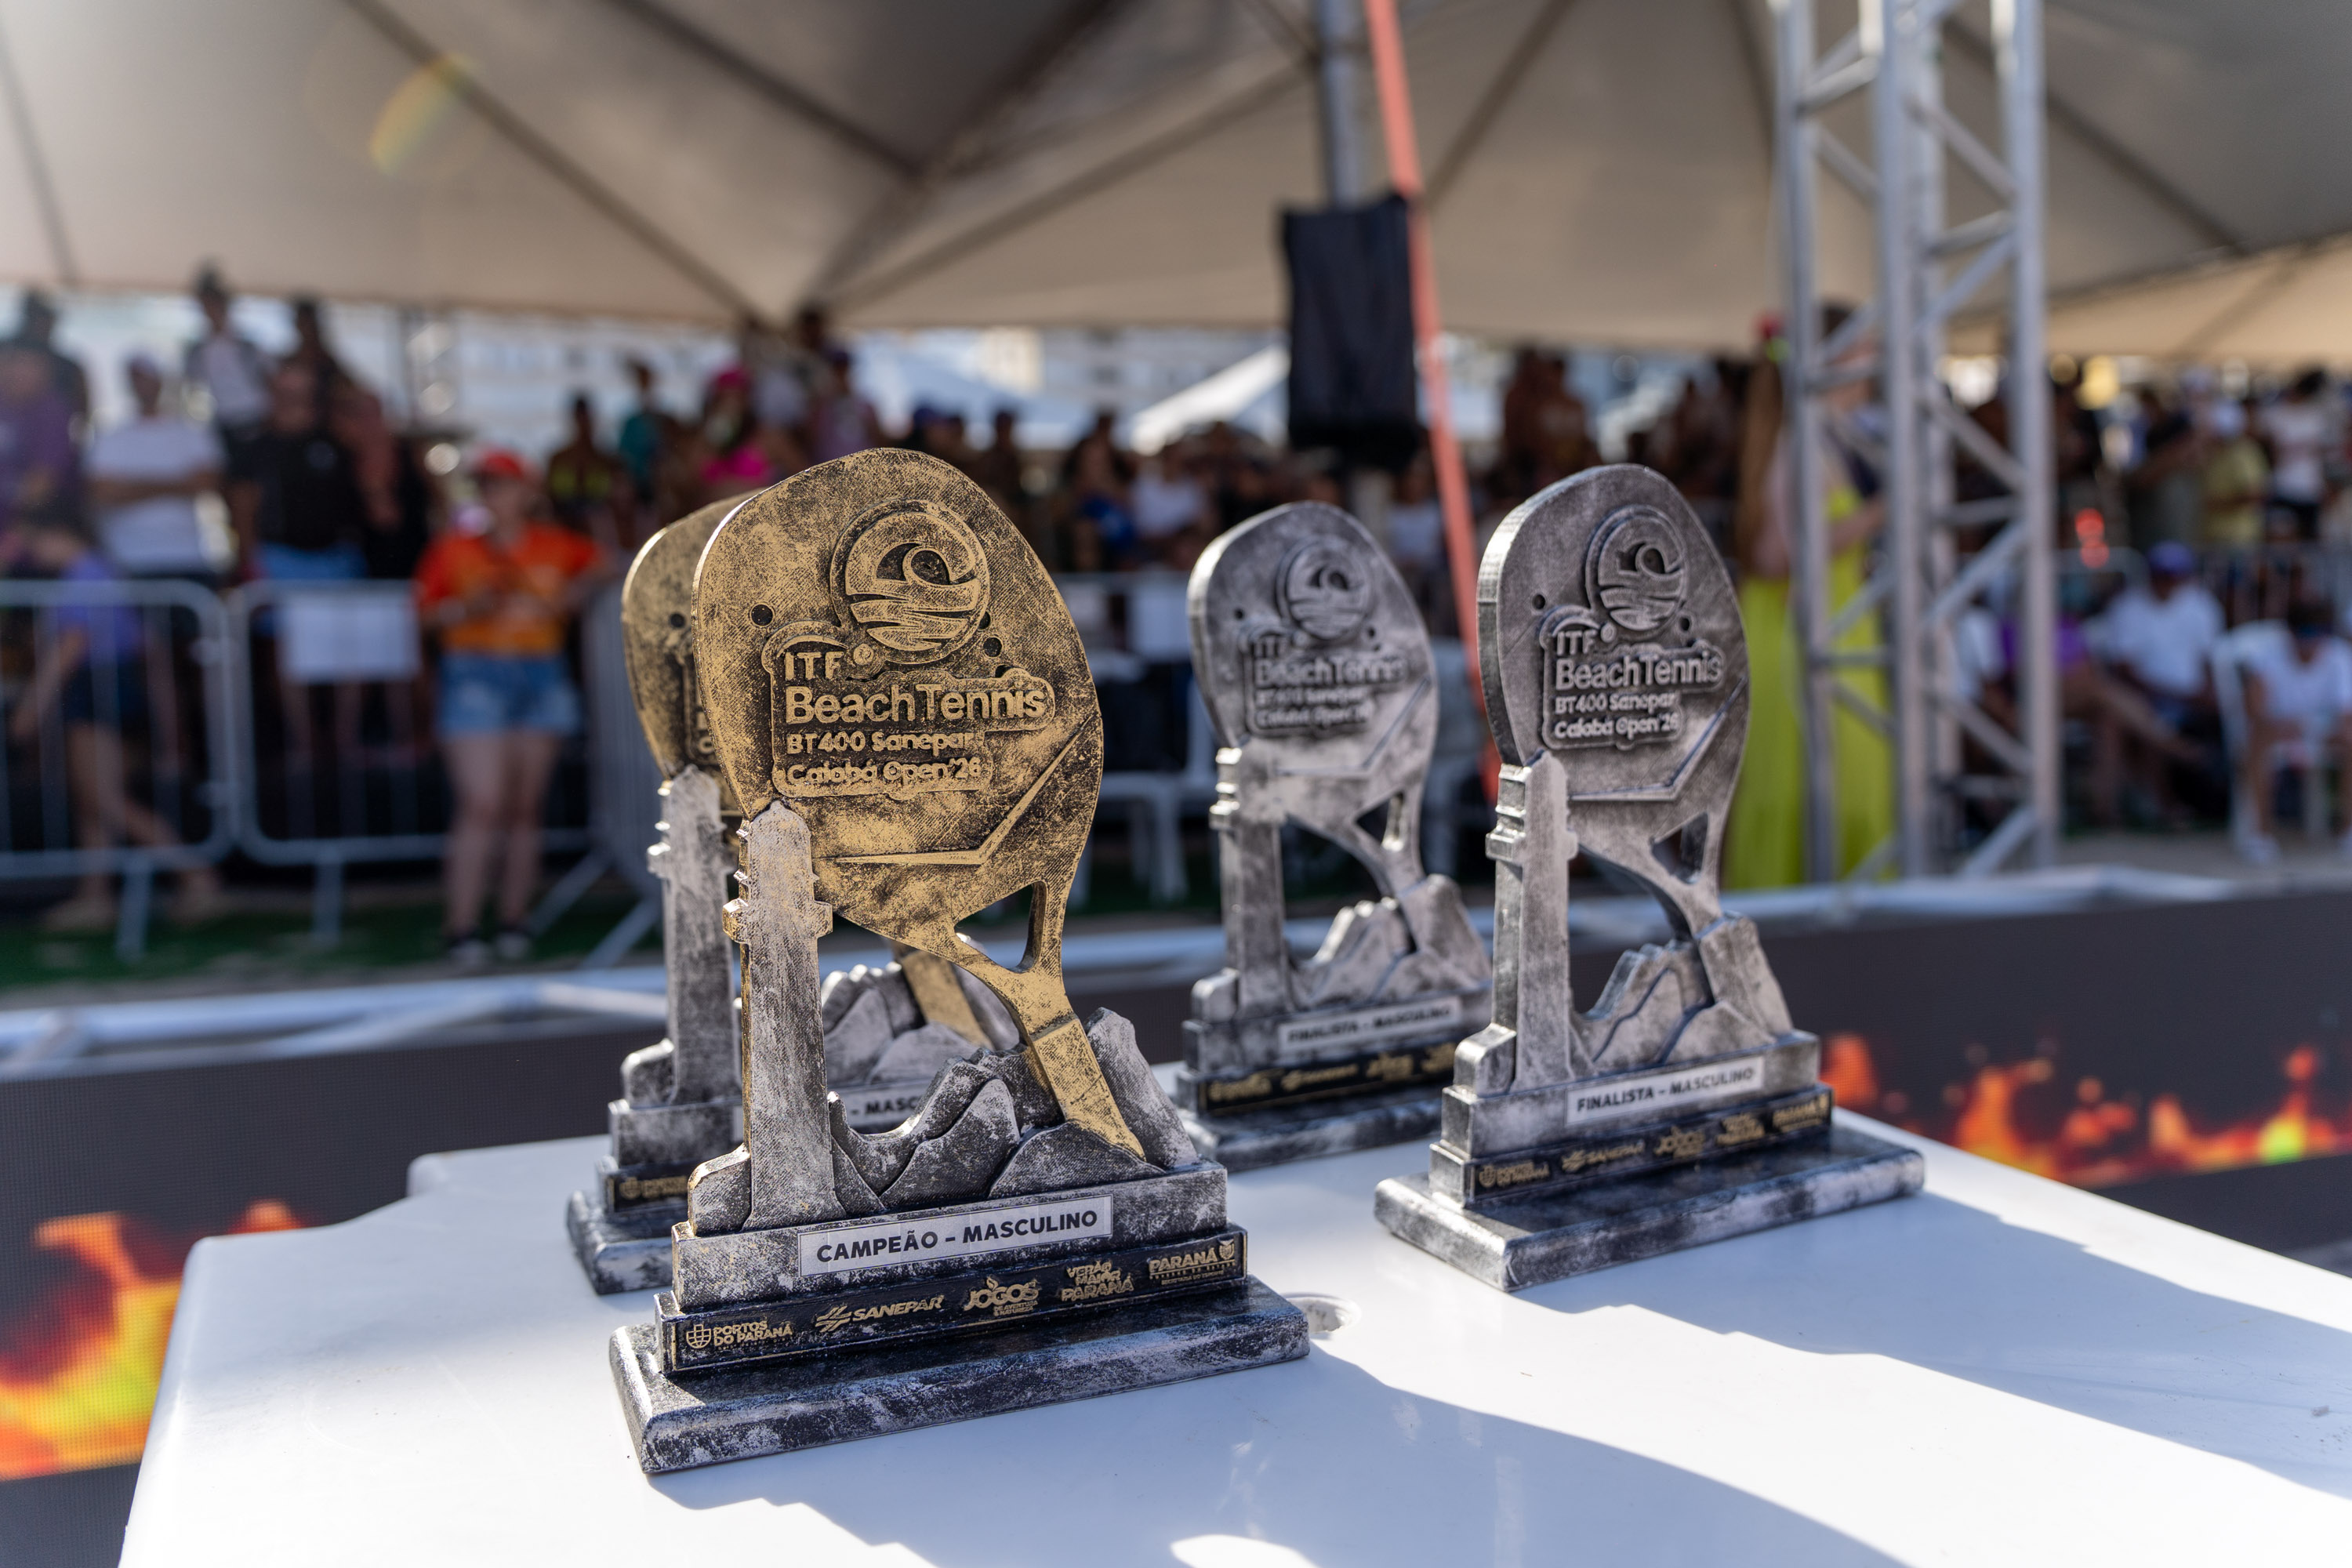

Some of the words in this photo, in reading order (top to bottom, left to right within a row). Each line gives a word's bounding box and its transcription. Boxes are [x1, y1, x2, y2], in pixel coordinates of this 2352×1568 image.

[1557, 630, 1598, 655] ITF
[785, 651, 844, 681] ITF
[786, 731, 866, 754] BT400
[871, 731, 975, 757] Sanepar
[1577, 1087, 1653, 1112] FINALISTA
[1669, 1067, 1755, 1094] MASCULINO
[816, 1229, 938, 1262] CAMPEÃO
[963, 1210, 1098, 1243] MASCULINO
[852, 1295, 945, 1322] SANEPAR
[964, 1279, 1040, 1311] JOGOS
[713, 1320, 768, 1336] PORTOS
[714, 1335, 734, 1347] DO
